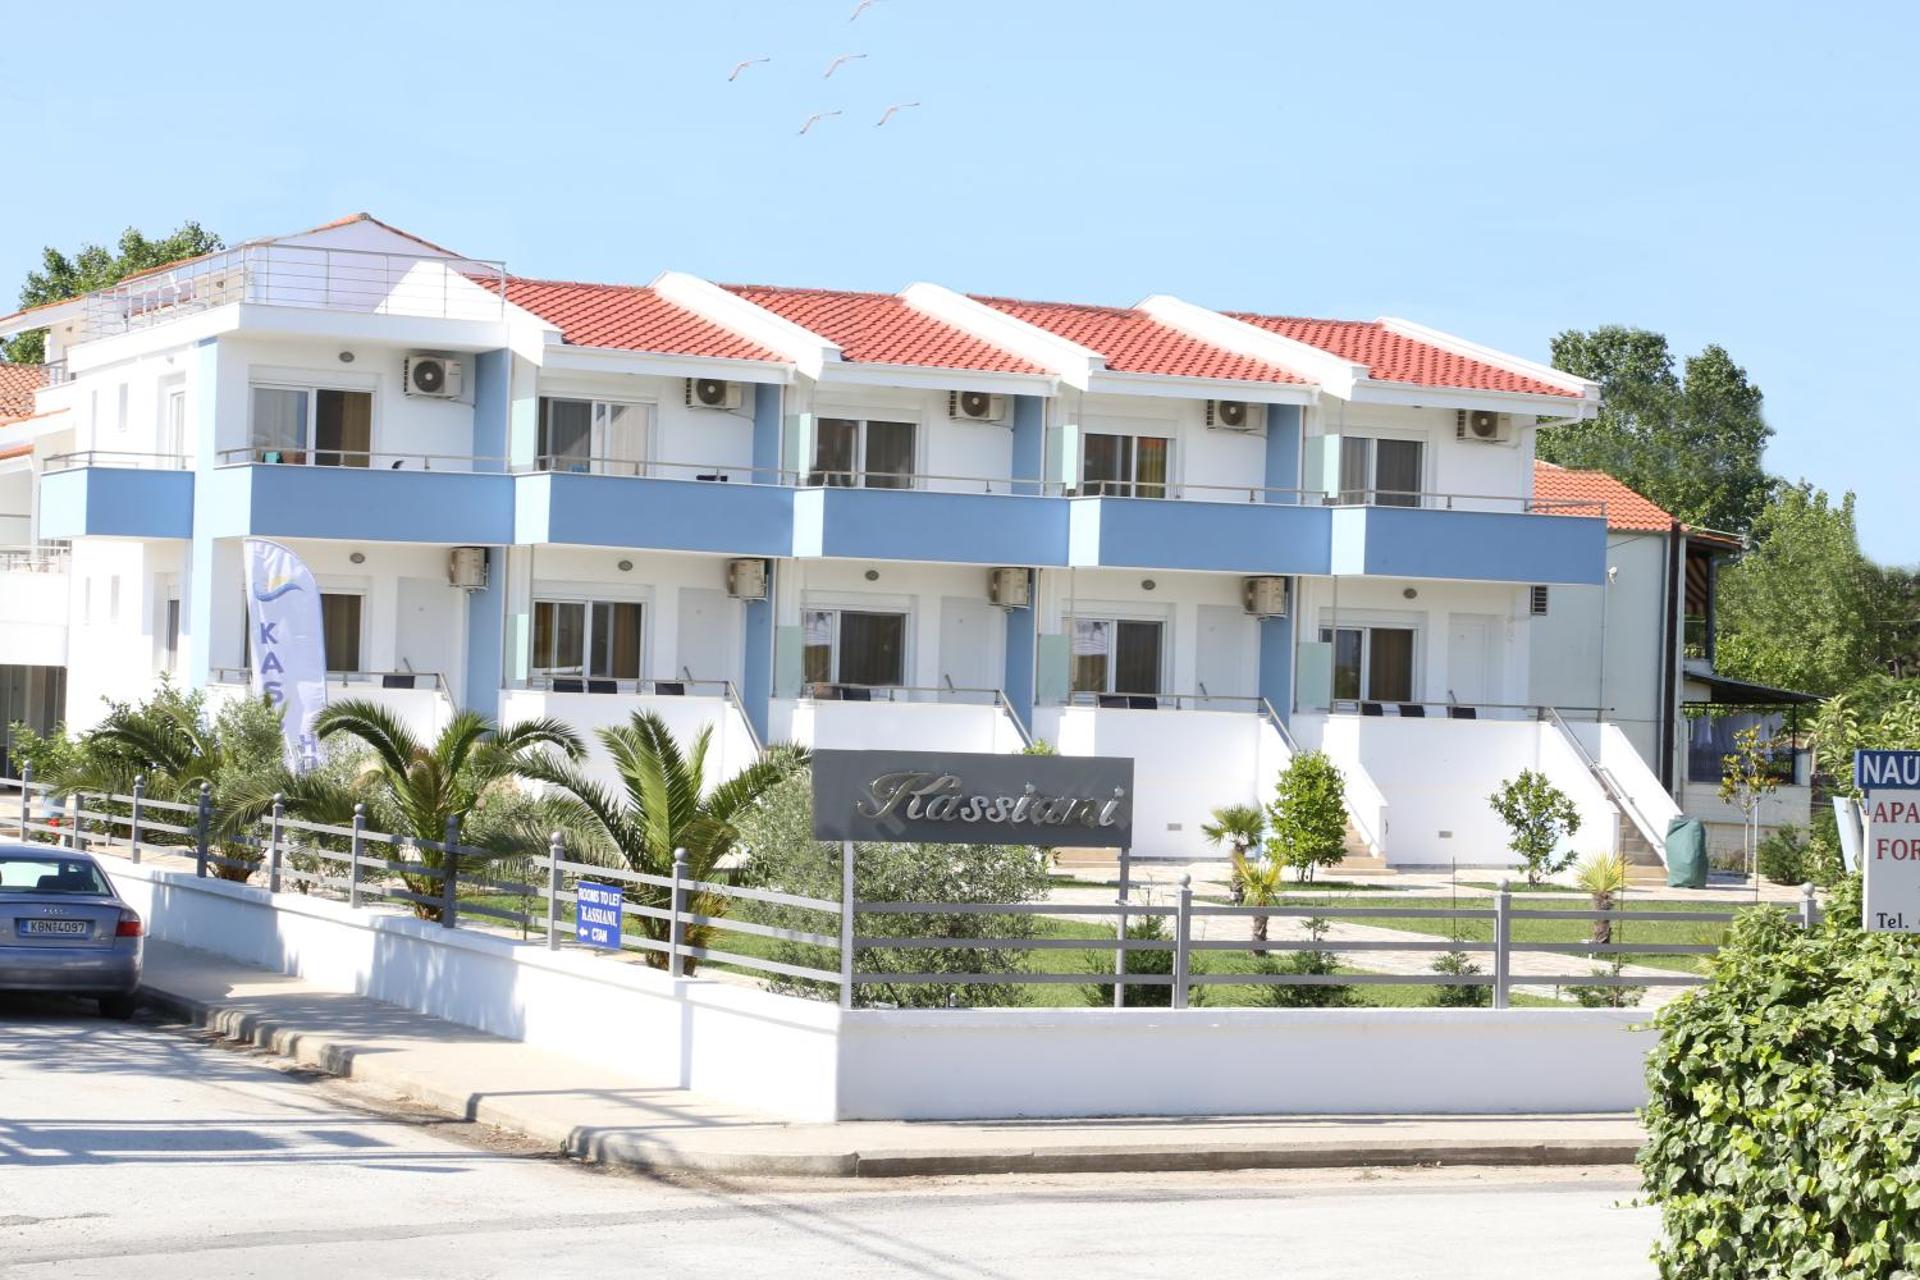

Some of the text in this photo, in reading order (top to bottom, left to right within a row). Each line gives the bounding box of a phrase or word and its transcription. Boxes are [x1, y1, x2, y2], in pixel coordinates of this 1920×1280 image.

[857, 771, 1125, 827] Kassiani
[578, 888, 621, 907] ROOMS TO LET
[1876, 912, 1909, 929] Tel.
